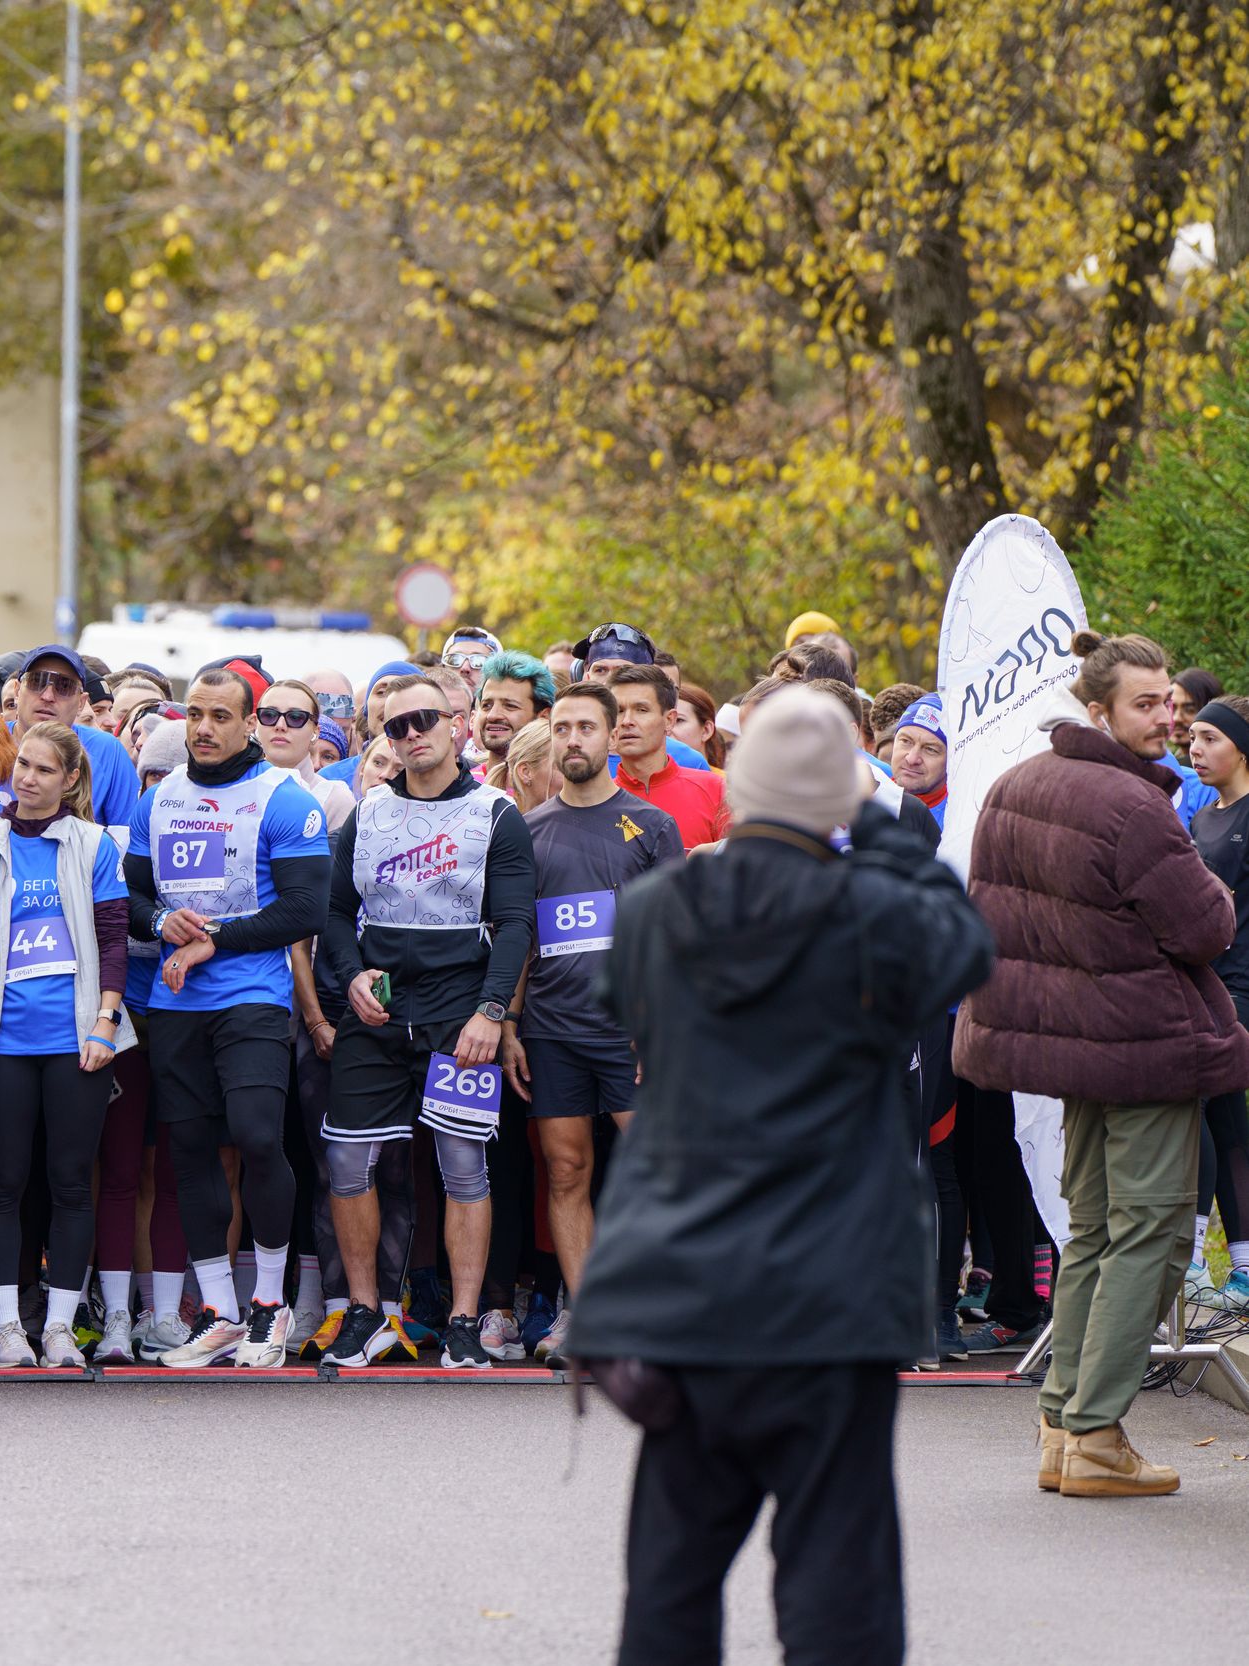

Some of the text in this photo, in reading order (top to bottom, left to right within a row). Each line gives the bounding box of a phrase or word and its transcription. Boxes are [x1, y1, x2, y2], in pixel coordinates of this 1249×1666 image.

[160, 799, 185, 809] ОРБИ
[170, 819, 234, 832] ПОМОГАЕМ
[172, 840, 207, 868] 87
[416, 859, 458, 883] team
[23, 879, 59, 892] БЕГУ
[21, 895, 62, 908] ЗА ОР
[555, 900, 597, 930] 85
[11, 925, 58, 955] 44
[434, 1063, 496, 1099] 269
[438, 1104, 459, 1115] ОРБИ
